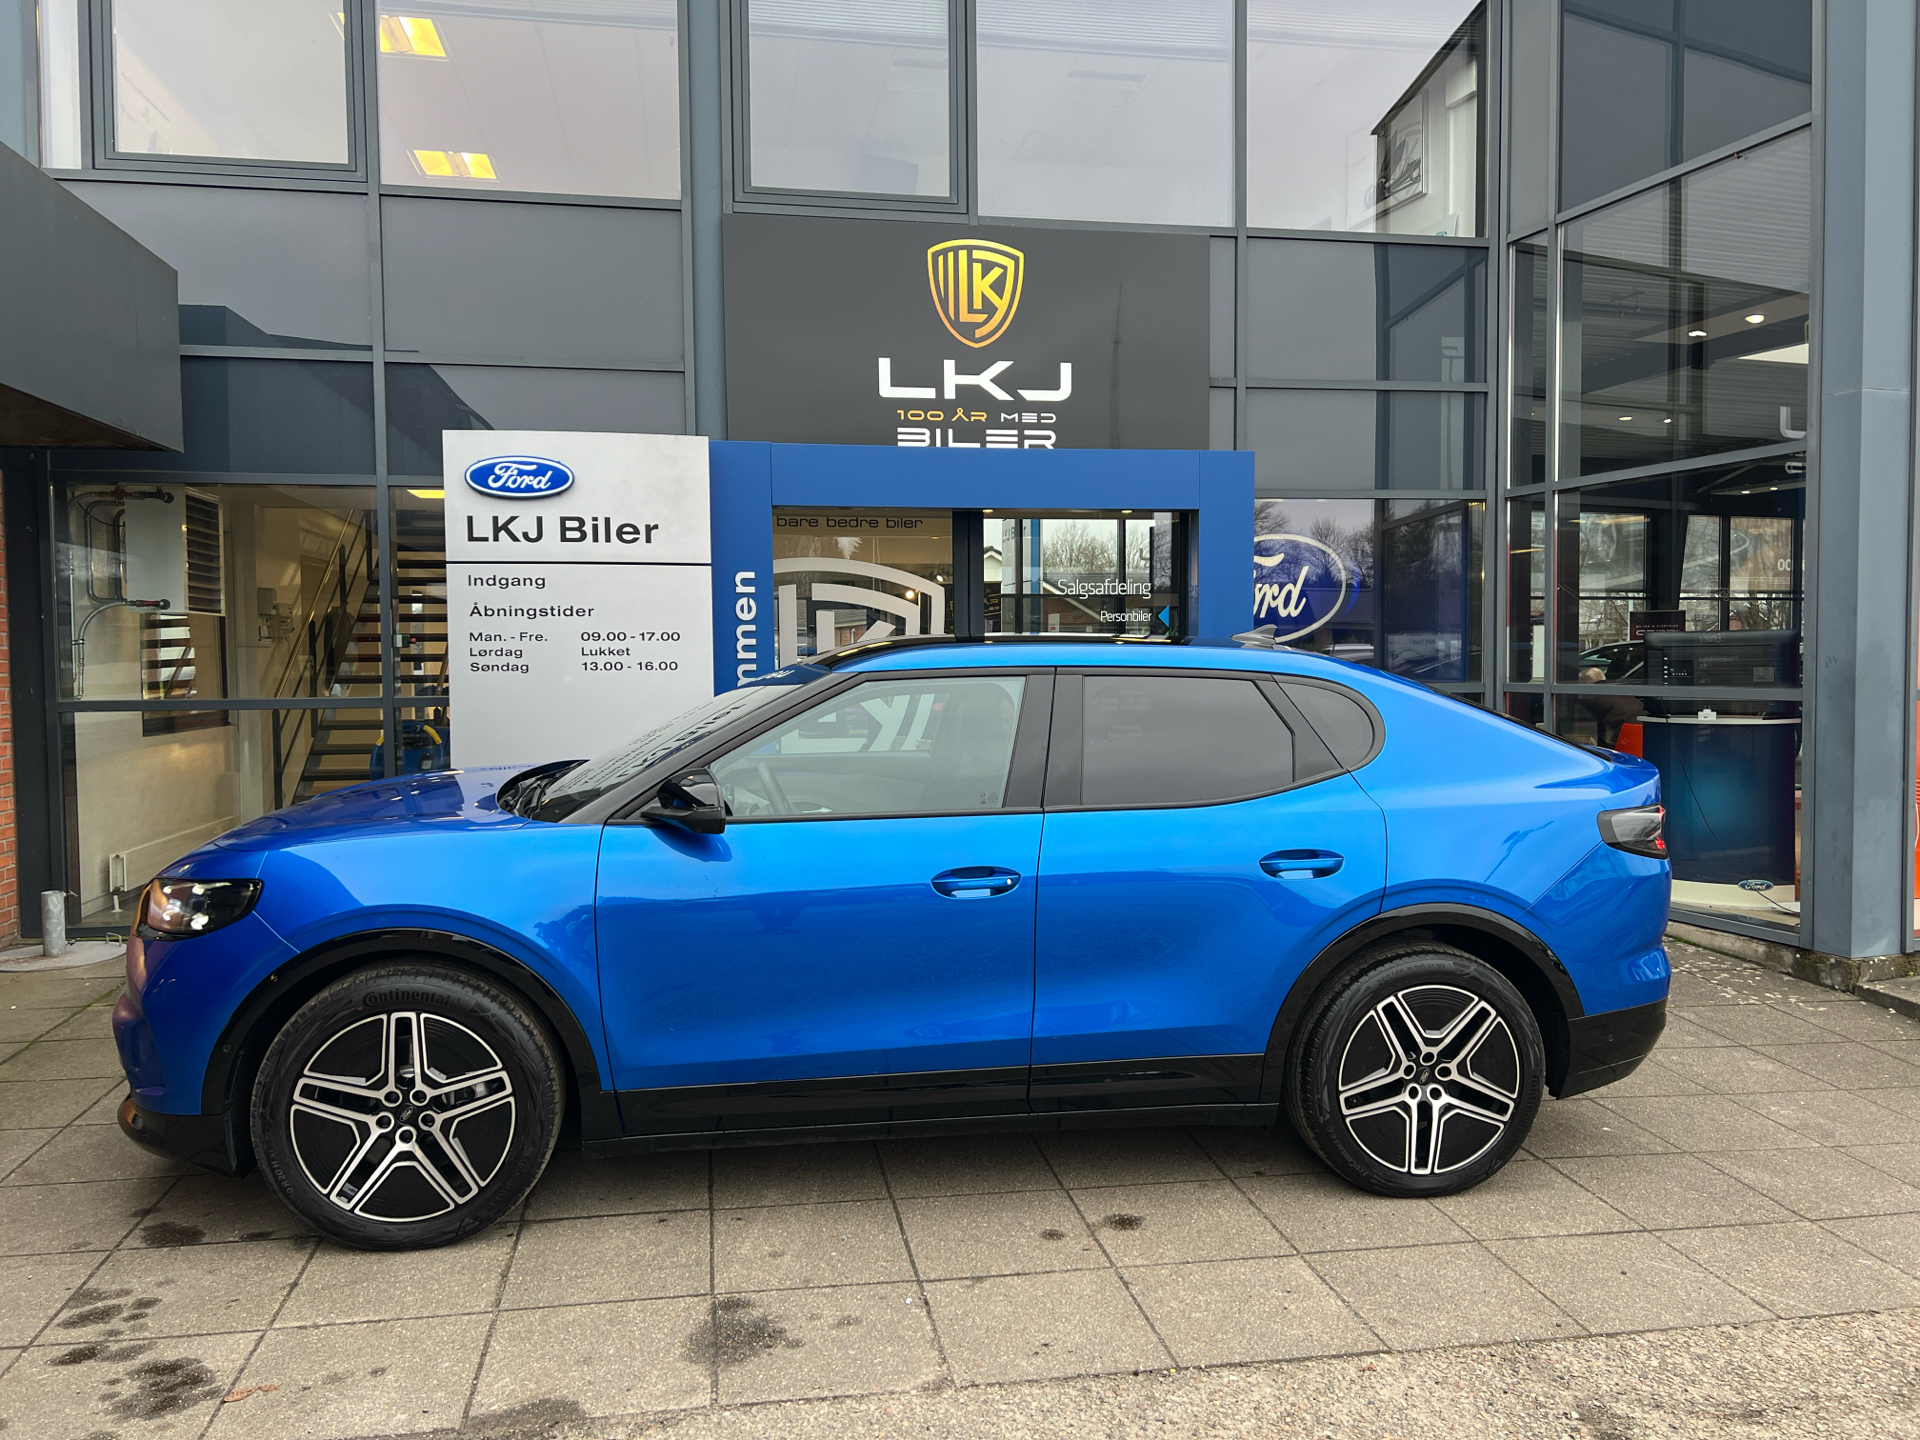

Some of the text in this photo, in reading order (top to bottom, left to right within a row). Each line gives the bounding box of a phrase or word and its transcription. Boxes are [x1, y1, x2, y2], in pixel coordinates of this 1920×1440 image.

[878, 357, 1072, 401] LKJ
[896, 407, 1057, 423] 100 ÅR MED
[897, 427, 1057, 449] BILER
[467, 515, 659, 544] LKJ Biler
[776, 516, 924, 528] bare bedre biler
[468, 574, 546, 589] Indgang
[1058, 578, 1152, 599] Salgsafdeling
[469, 602, 594, 620] Åbningstider
[1100, 610, 1152, 622] Personbiler
[469, 632, 507, 642] Man.
[519, 632, 548, 642] Fre.
[580, 631, 627, 642] 09.00
[638, 631, 681, 642] 17.00
[469, 647, 631, 658] Lørdag Lukket
[470, 663, 530, 674] Søndag
[581, 662, 624, 671] 13.00
[636, 662, 679, 671] 16.00
[361, 987, 451, 1009] Continental
